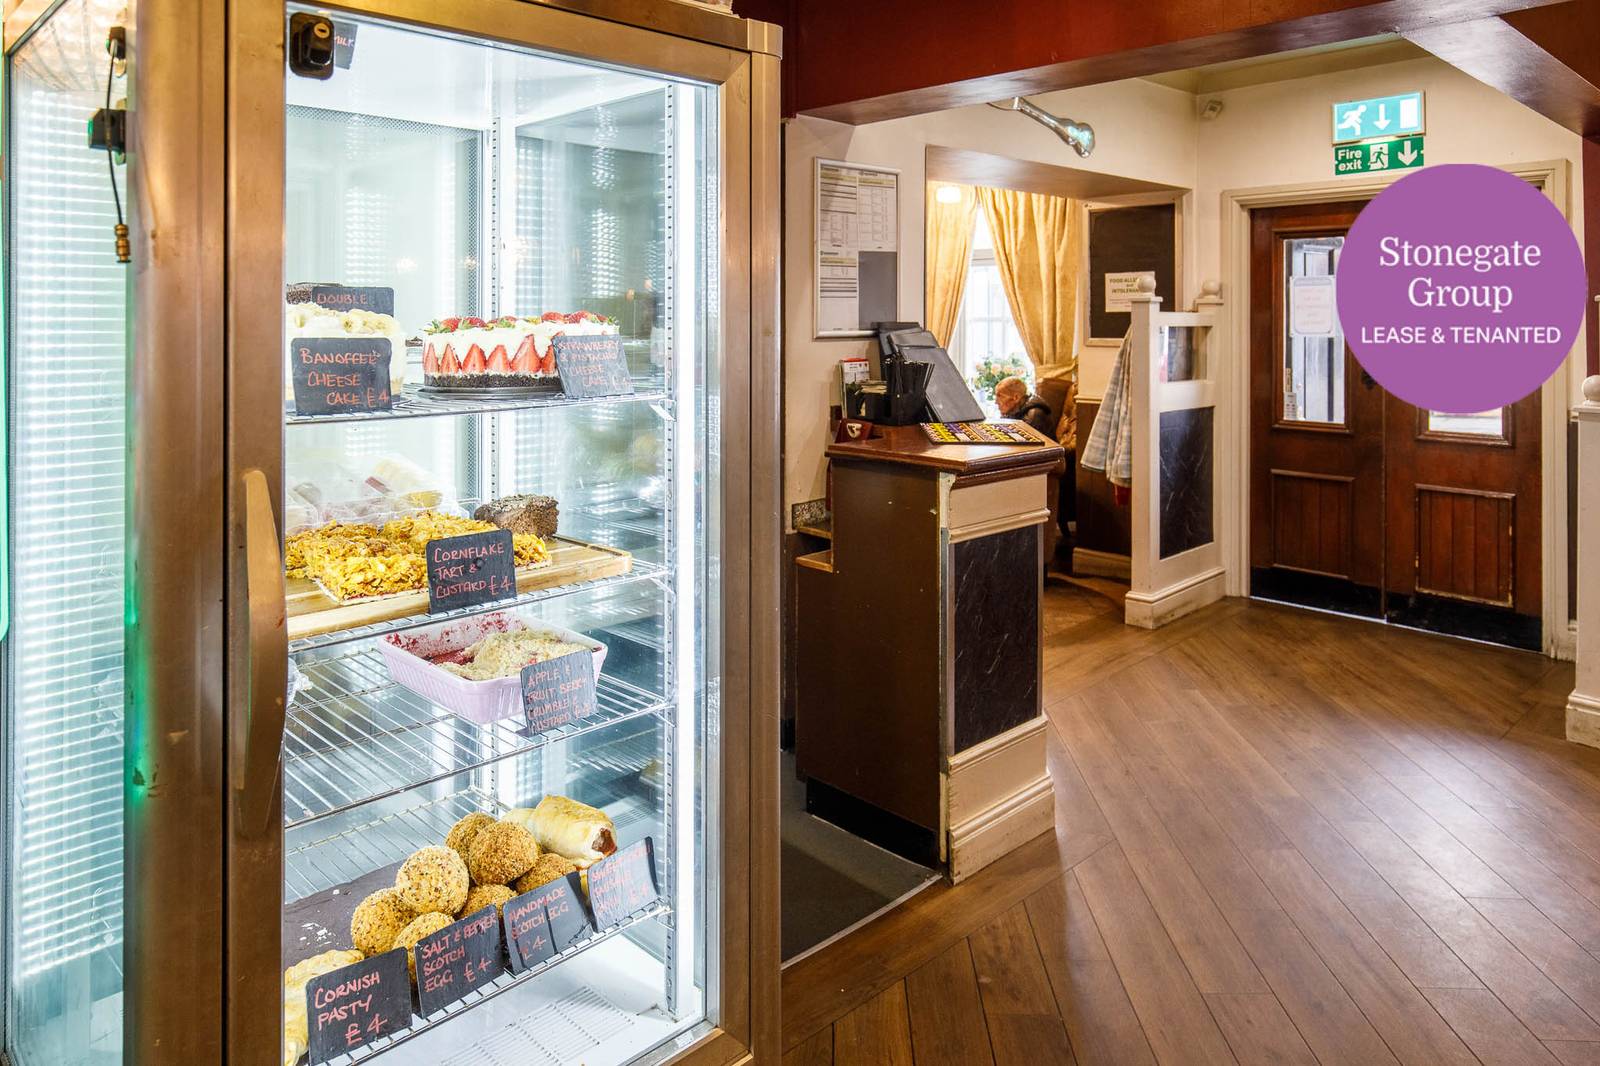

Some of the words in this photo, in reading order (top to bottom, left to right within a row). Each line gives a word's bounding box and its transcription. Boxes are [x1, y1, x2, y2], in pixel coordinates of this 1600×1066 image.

[1337, 148, 1363, 161] Fire
[1338, 159, 1363, 172] exit
[316, 292, 367, 305] DOUBLE
[299, 347, 379, 365] BANOFFEE
[307, 371, 361, 388] CHEESE
[326, 390, 361, 406] CAKE
[434, 542, 505, 564] CORNFLAKE
[434, 564, 465, 581] TART
[469, 563, 478, 573] &
[436, 580, 487, 599] CUSTARD
[527, 668, 560, 689] APPLE
[527, 687, 556, 704] FRUIT
[527, 698, 569, 720] CRUMBLE
[508, 885, 566, 923] HANDMADE
[511, 912, 545, 941] SCOTCH
[548, 900, 569, 920] EGG
[421, 933, 451, 960] SALT
[463, 912, 497, 940] PEPPER
[423, 945, 466, 977] SCOTCH
[314, 970, 380, 1009] CORNISH
[424, 969, 454, 993] EGG
[317, 993, 373, 1032] PASTY
